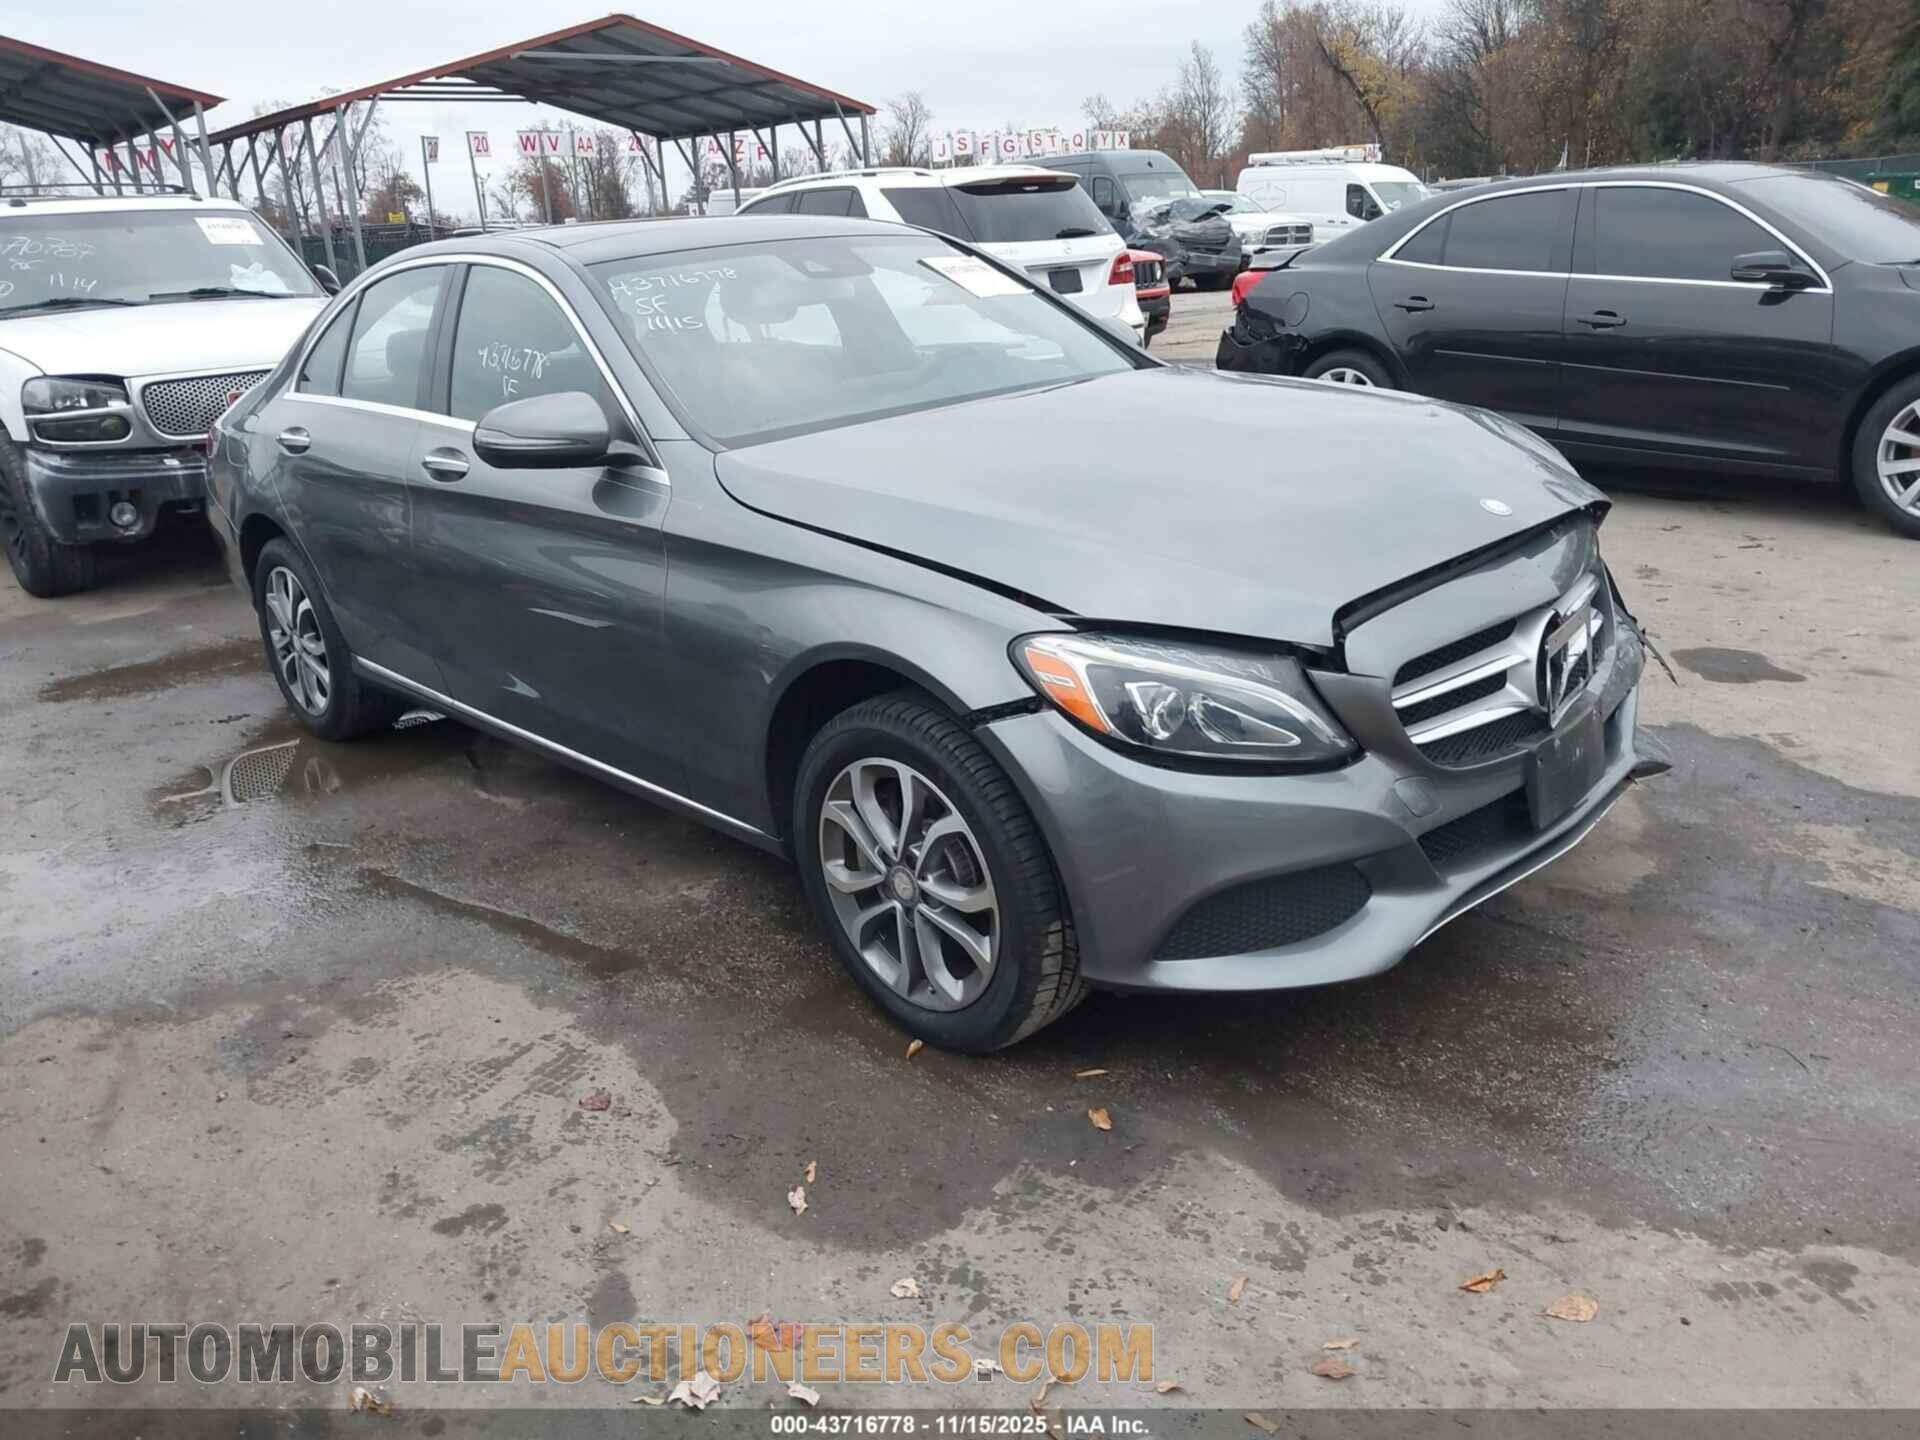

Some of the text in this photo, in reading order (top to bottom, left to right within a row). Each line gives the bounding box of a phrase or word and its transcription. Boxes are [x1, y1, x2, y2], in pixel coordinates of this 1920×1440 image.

[472, 135, 490, 153] 20
[519, 135, 537, 152] W
[547, 135, 560, 152] V
[576, 135, 594, 153] AA
[957, 137, 969, 151] S
[1003, 139, 1016, 153] G
[1072, 133, 1084, 148] Q
[1101, 132, 1111, 147] Y
[1117, 132, 1127, 147] X
[607, 266, 737, 301] 43716778
[635, 294, 668, 316] SF
